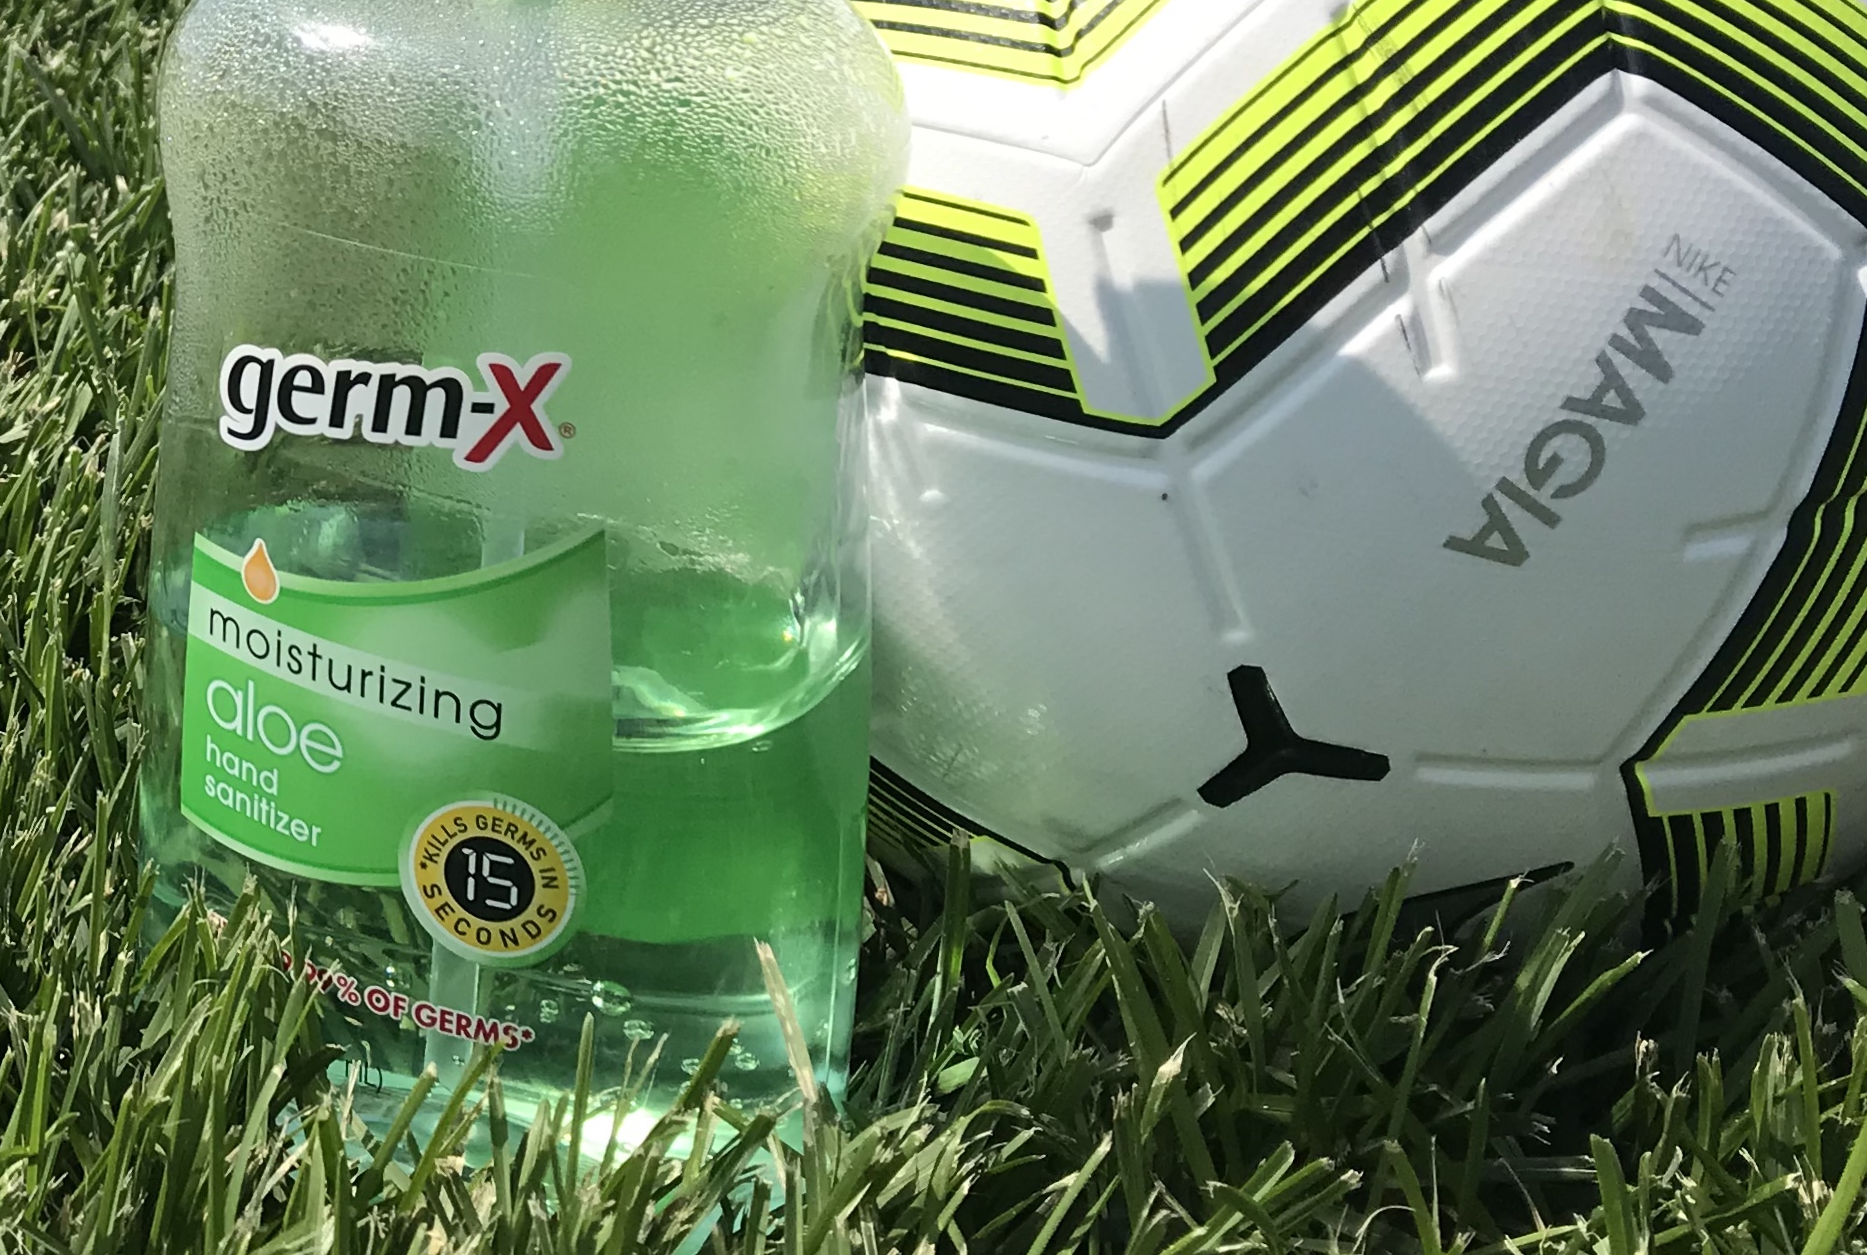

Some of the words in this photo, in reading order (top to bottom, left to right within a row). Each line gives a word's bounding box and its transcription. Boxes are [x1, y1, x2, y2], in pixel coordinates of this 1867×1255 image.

[1663, 233, 1736, 297] NIKE
[1442, 284, 1707, 567] MAGIA
[209, 606, 503, 741] moisturizing
[206, 678, 344, 774] aloe
[205, 735, 279, 796] hand
[204, 772, 322, 847] sanitizer
[461, 846, 519, 911] 15
[475, 813, 546, 868] GERMS
[537, 866, 560, 891] IN
[422, 882, 557, 949] SECONDS
[366, 986, 407, 1021] OF
